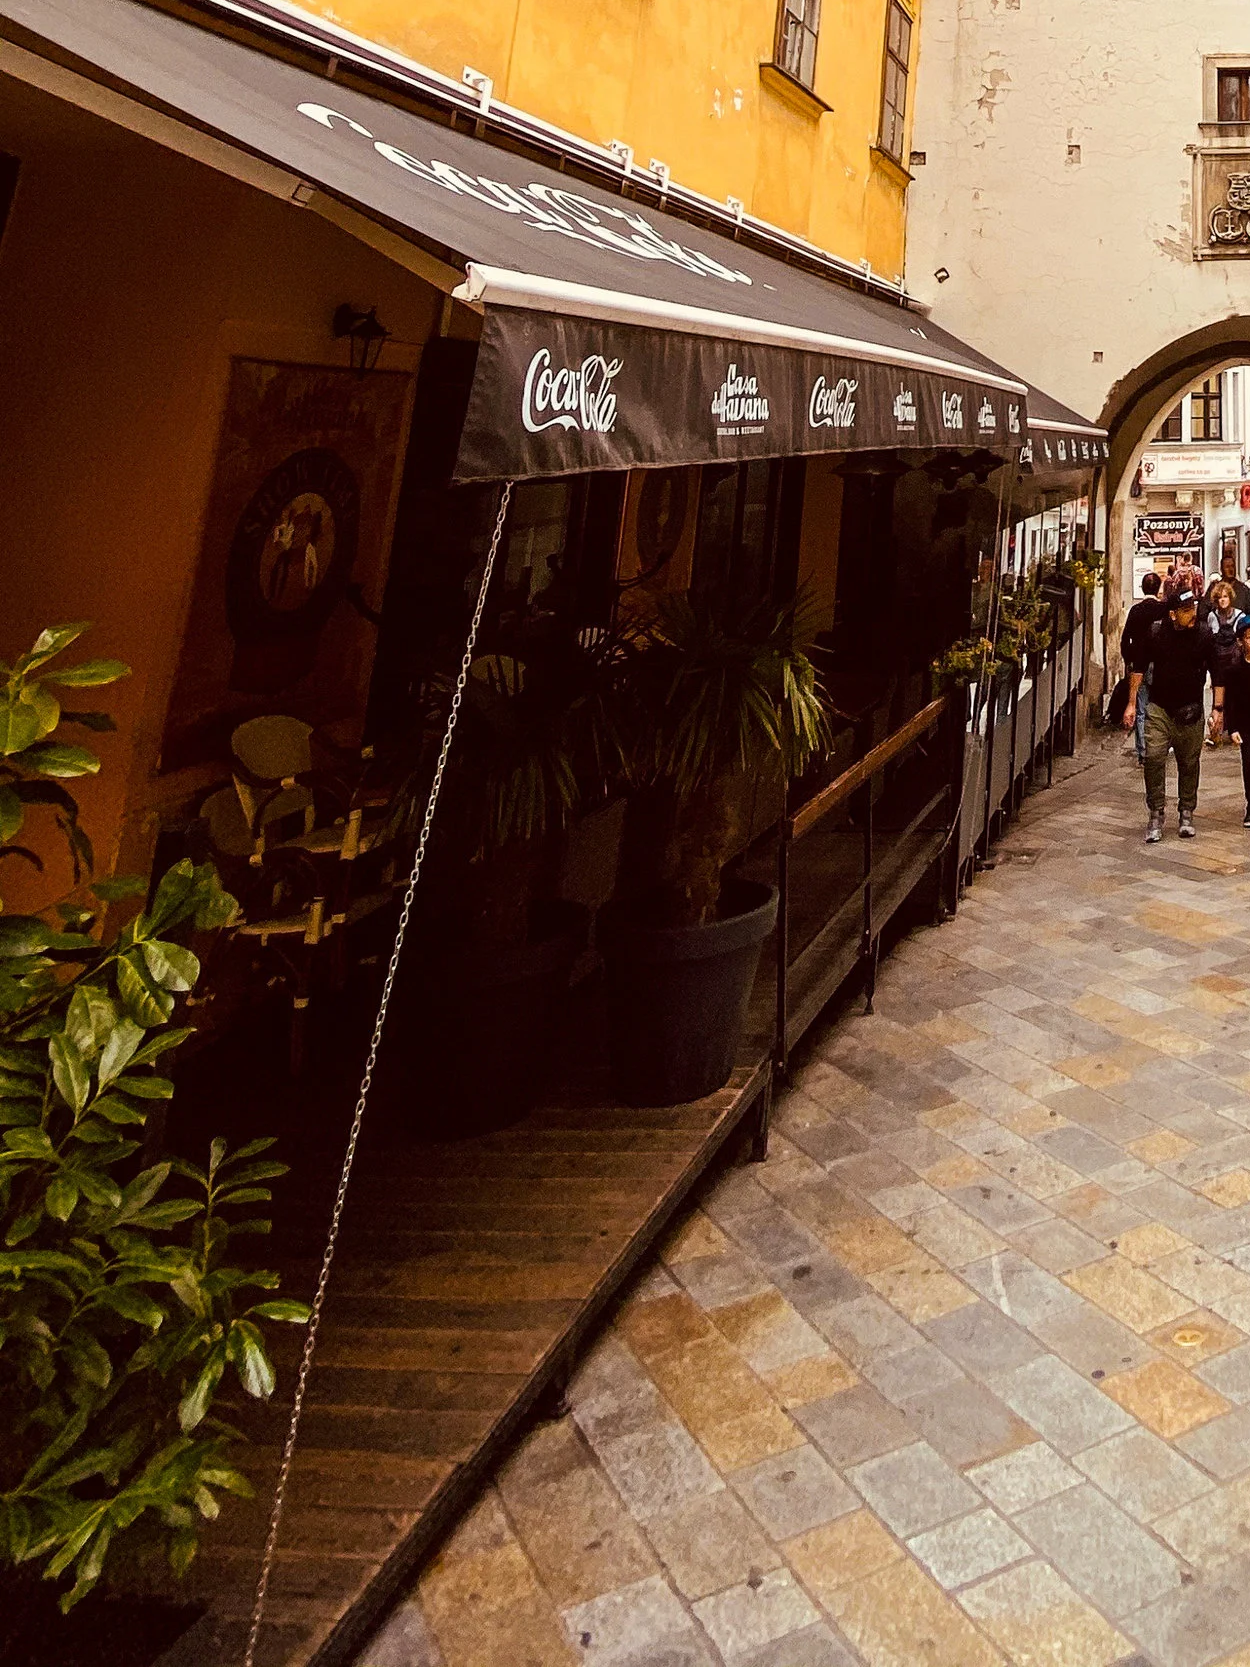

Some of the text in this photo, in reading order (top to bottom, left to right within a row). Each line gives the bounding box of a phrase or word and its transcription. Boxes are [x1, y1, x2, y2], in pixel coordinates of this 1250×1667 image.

[727, 363, 758, 397] Casa
[720, 382, 769, 422] Havana
[1143, 518, 1194, 531] Pozsonyi
